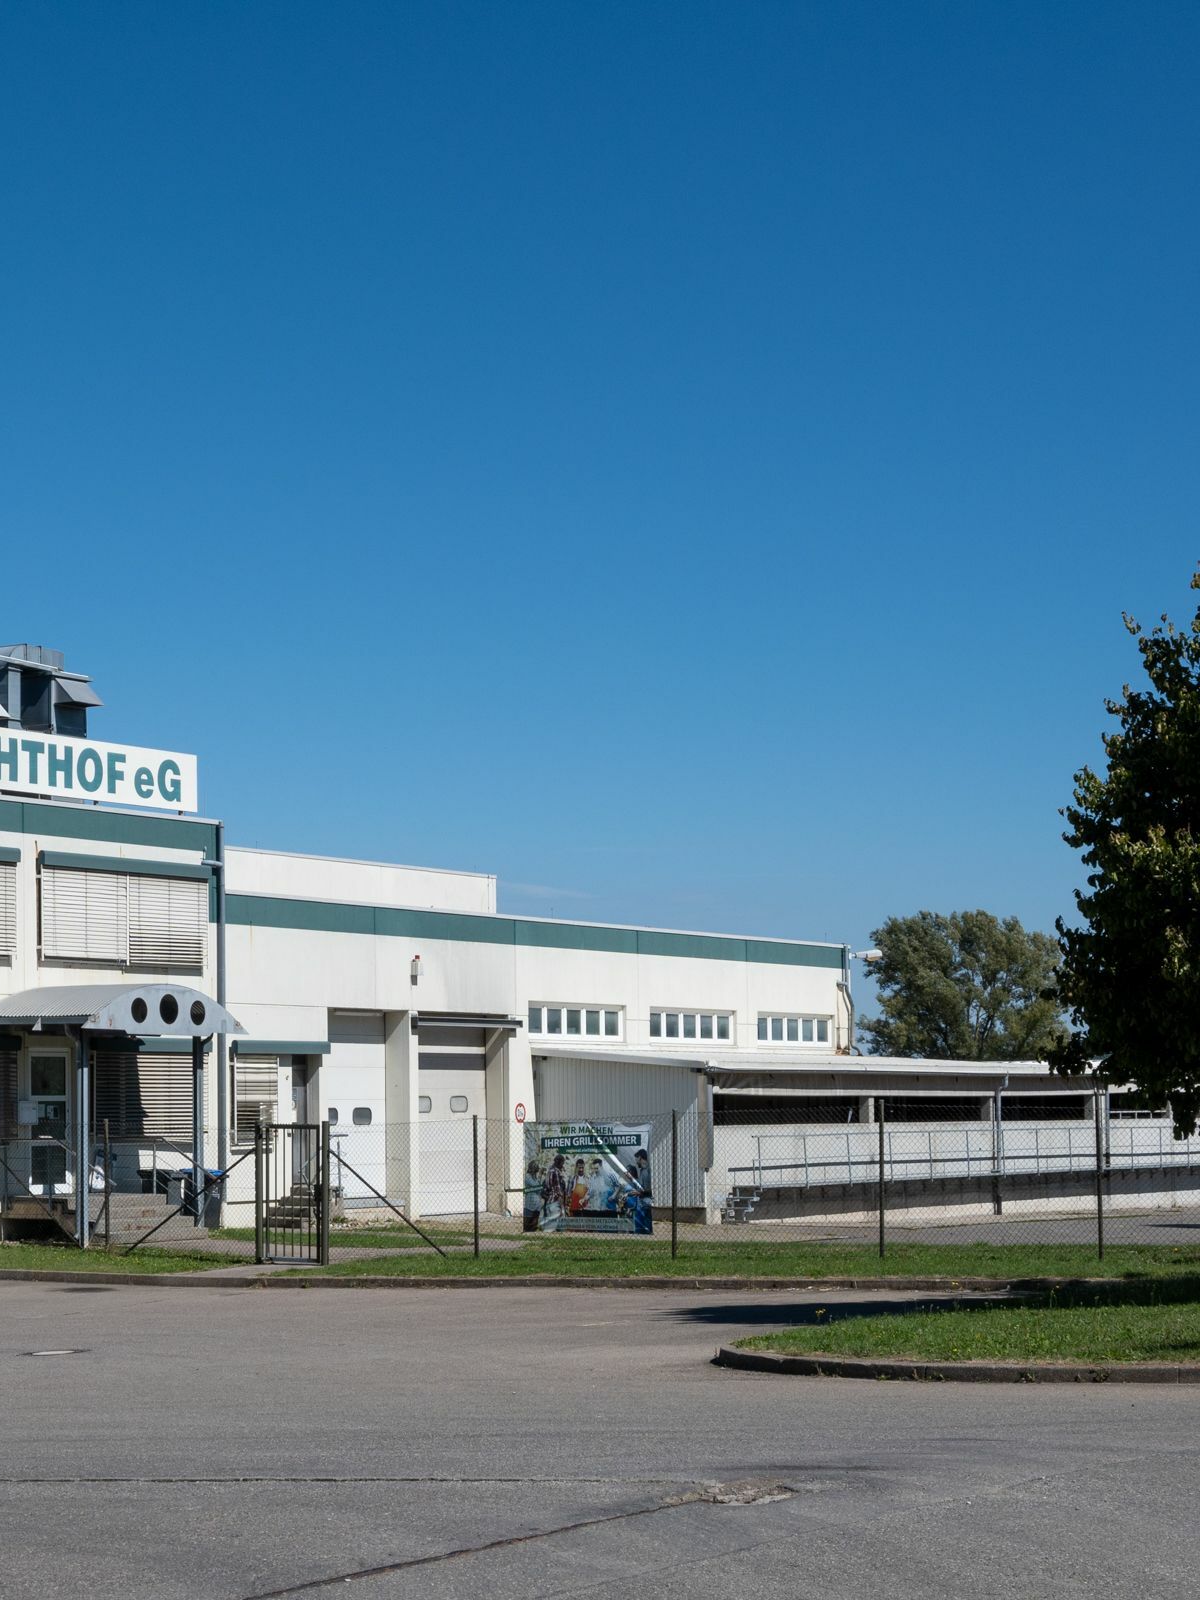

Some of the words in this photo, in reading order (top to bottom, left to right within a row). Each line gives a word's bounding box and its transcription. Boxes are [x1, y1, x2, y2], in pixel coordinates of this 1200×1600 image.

[134, 758, 182, 803] eG
[559, 1126, 577, 1135] WIR
[544, 1137, 571, 1148] IHREN
[572, 1135, 637, 1146] GRILLSOMMER
